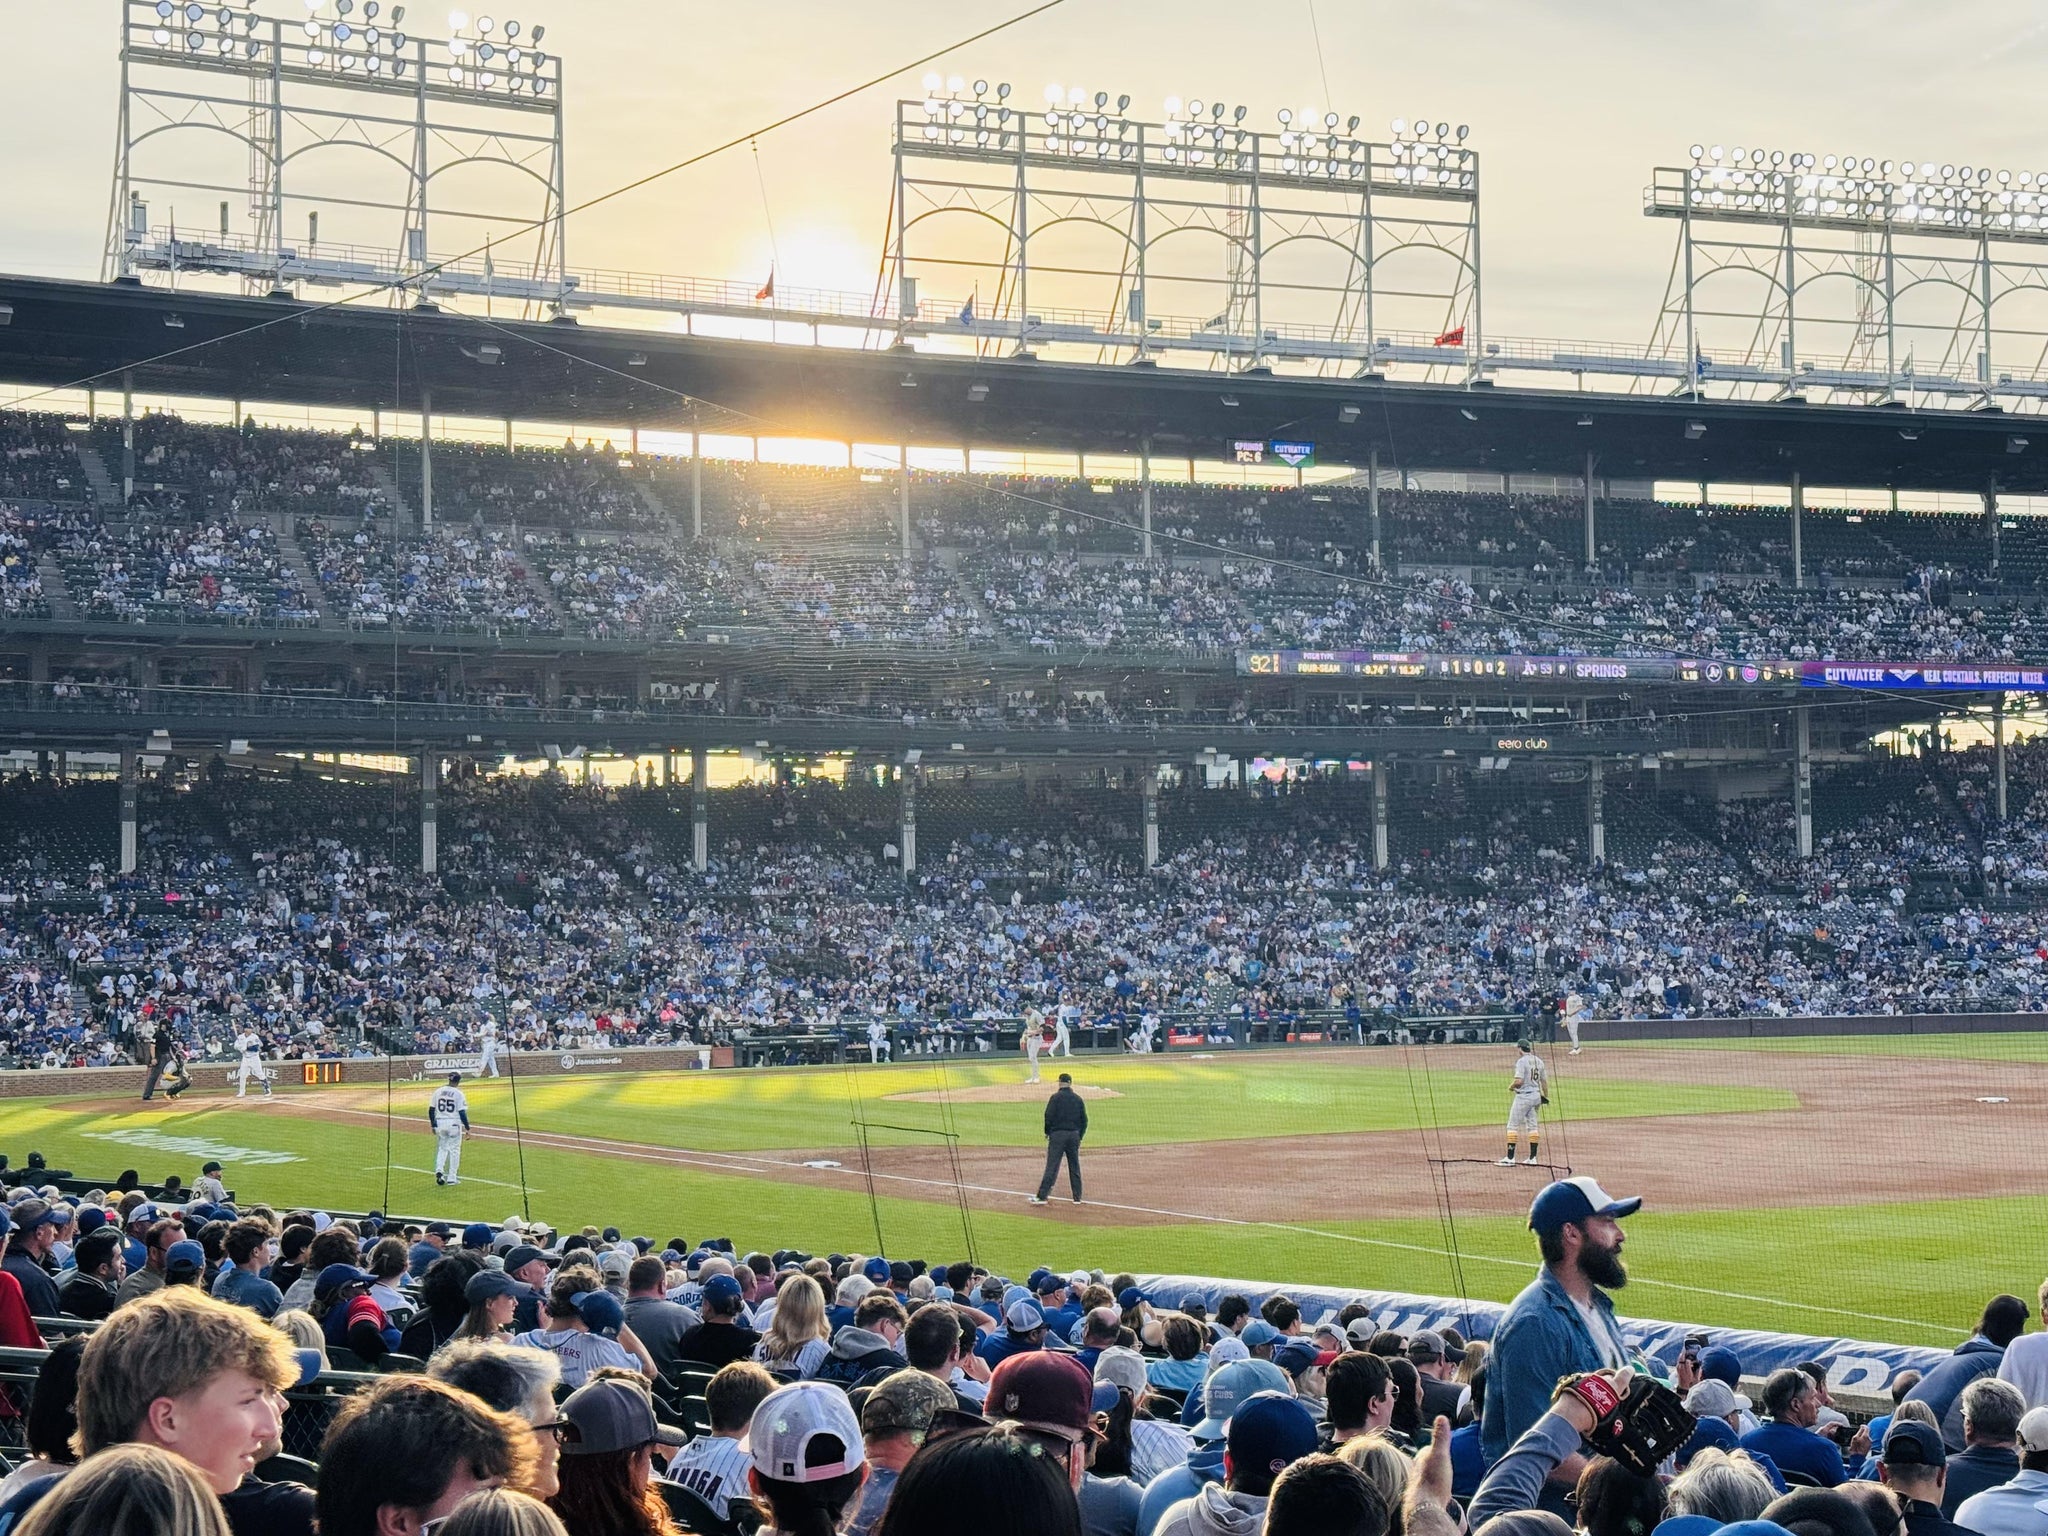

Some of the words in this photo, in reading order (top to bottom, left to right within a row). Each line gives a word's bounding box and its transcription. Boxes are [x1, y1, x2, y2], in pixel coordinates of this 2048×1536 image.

[1274, 444, 1311, 455] CUTWATER
[1236, 450, 1254, 462] PC:
[1254, 451, 1262, 463] 6
[1297, 663, 1341, 673] FOUR-SEAM
[1452, 660, 1460, 675] 1
[1463, 661, 1472, 673] S
[1474, 660, 1484, 675] 0
[1496, 661, 1506, 676] 2
[1558, 664, 1566, 675] P
[1576, 663, 1627, 678] SPRINGS
[1726, 666, 1735, 681] 1
[1824, 667, 1884, 682] CUTWATER
[1923, 669, 1942, 683] REAL
[1942, 670, 1983, 684] COCKTAILS.
[1983, 671, 2019, 684] PERFECTLY
[2021, 671, 2046, 685] MIXED.
[1497, 738, 1522, 750] eero
[1524, 737, 1548, 750] club
[423, 1058, 481, 1069] GRAINGER
[575, 1057, 623, 1066] JamesHardie
[226, 1068, 279, 1081] MAEE
[1530, 1067, 1539, 1081] 16
[437, 1098, 456, 1113] 65
[1214, 1390, 1234, 1400] CUBS
